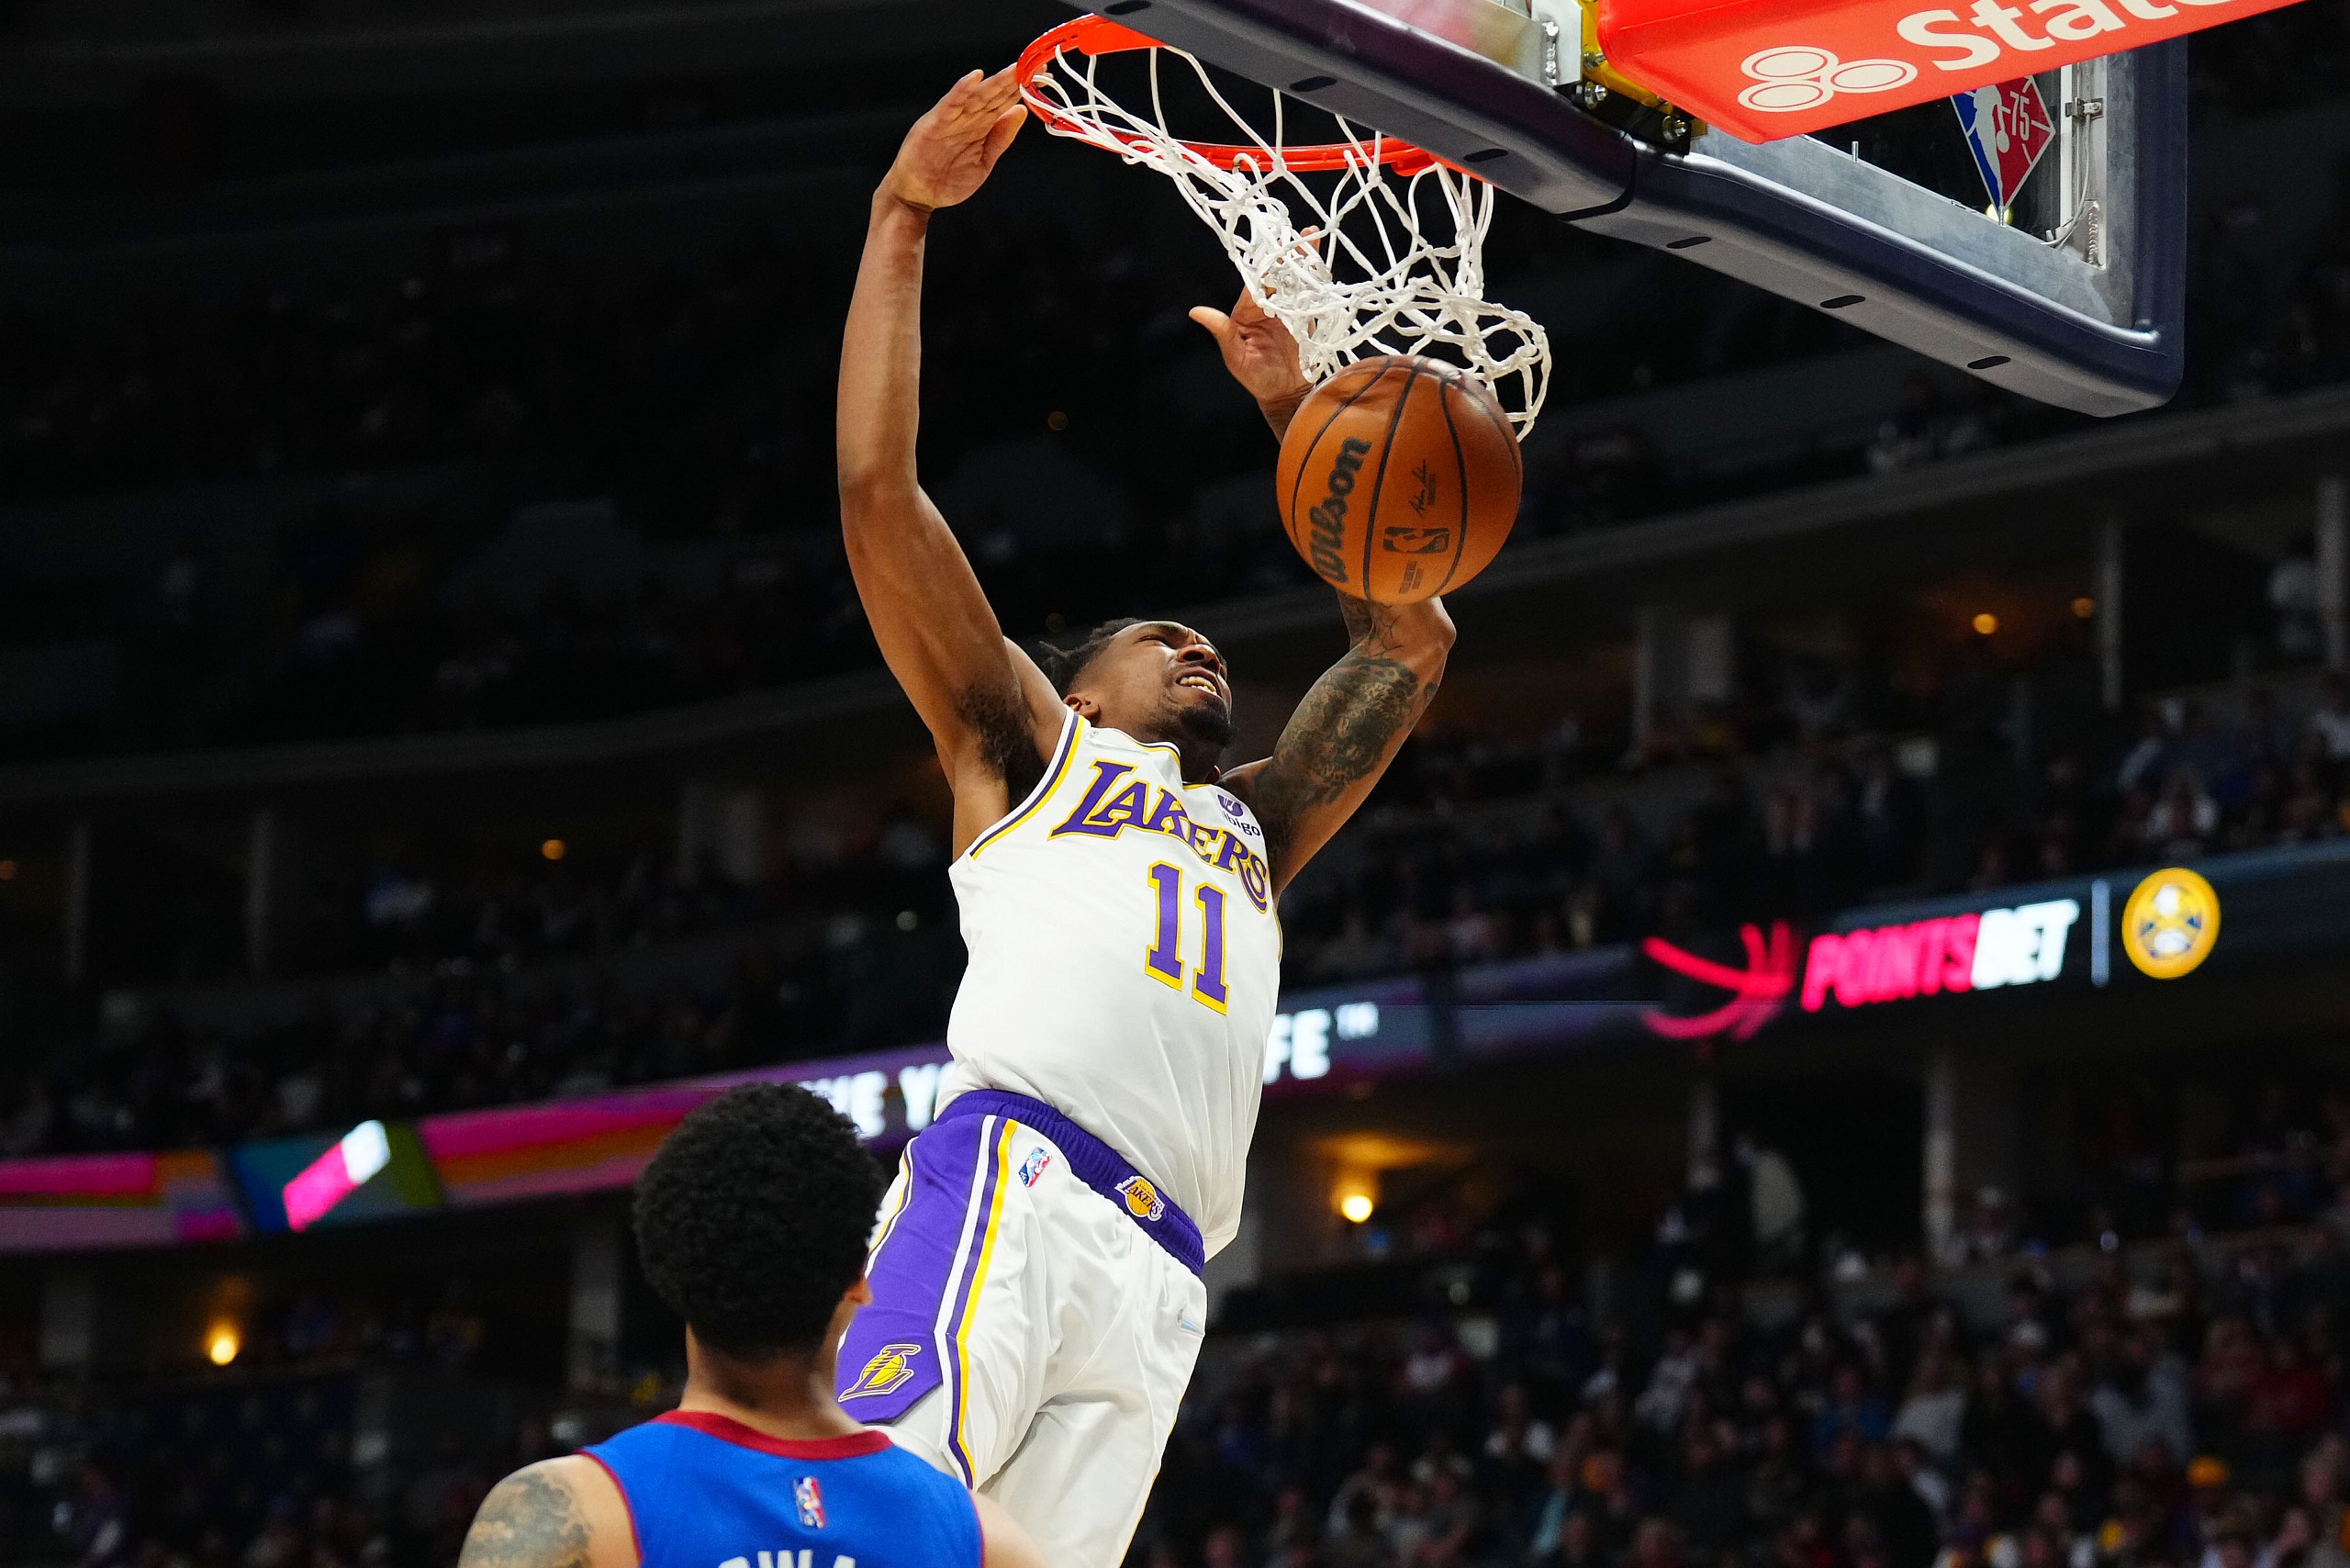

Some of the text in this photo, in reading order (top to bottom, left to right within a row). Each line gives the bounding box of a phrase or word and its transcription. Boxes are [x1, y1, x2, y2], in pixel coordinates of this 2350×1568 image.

[1897, 0, 2236, 71] Sta
[2009, 90, 2031, 141] 75
[1309, 436, 1372, 583] Wilson
[1047, 758, 1269, 914] LAKERS
[1145, 860, 1229, 1016] 11
[1800, 899, 2080, 1013] POINTSBET
[1120, 1179, 1161, 1219] LAKERS
